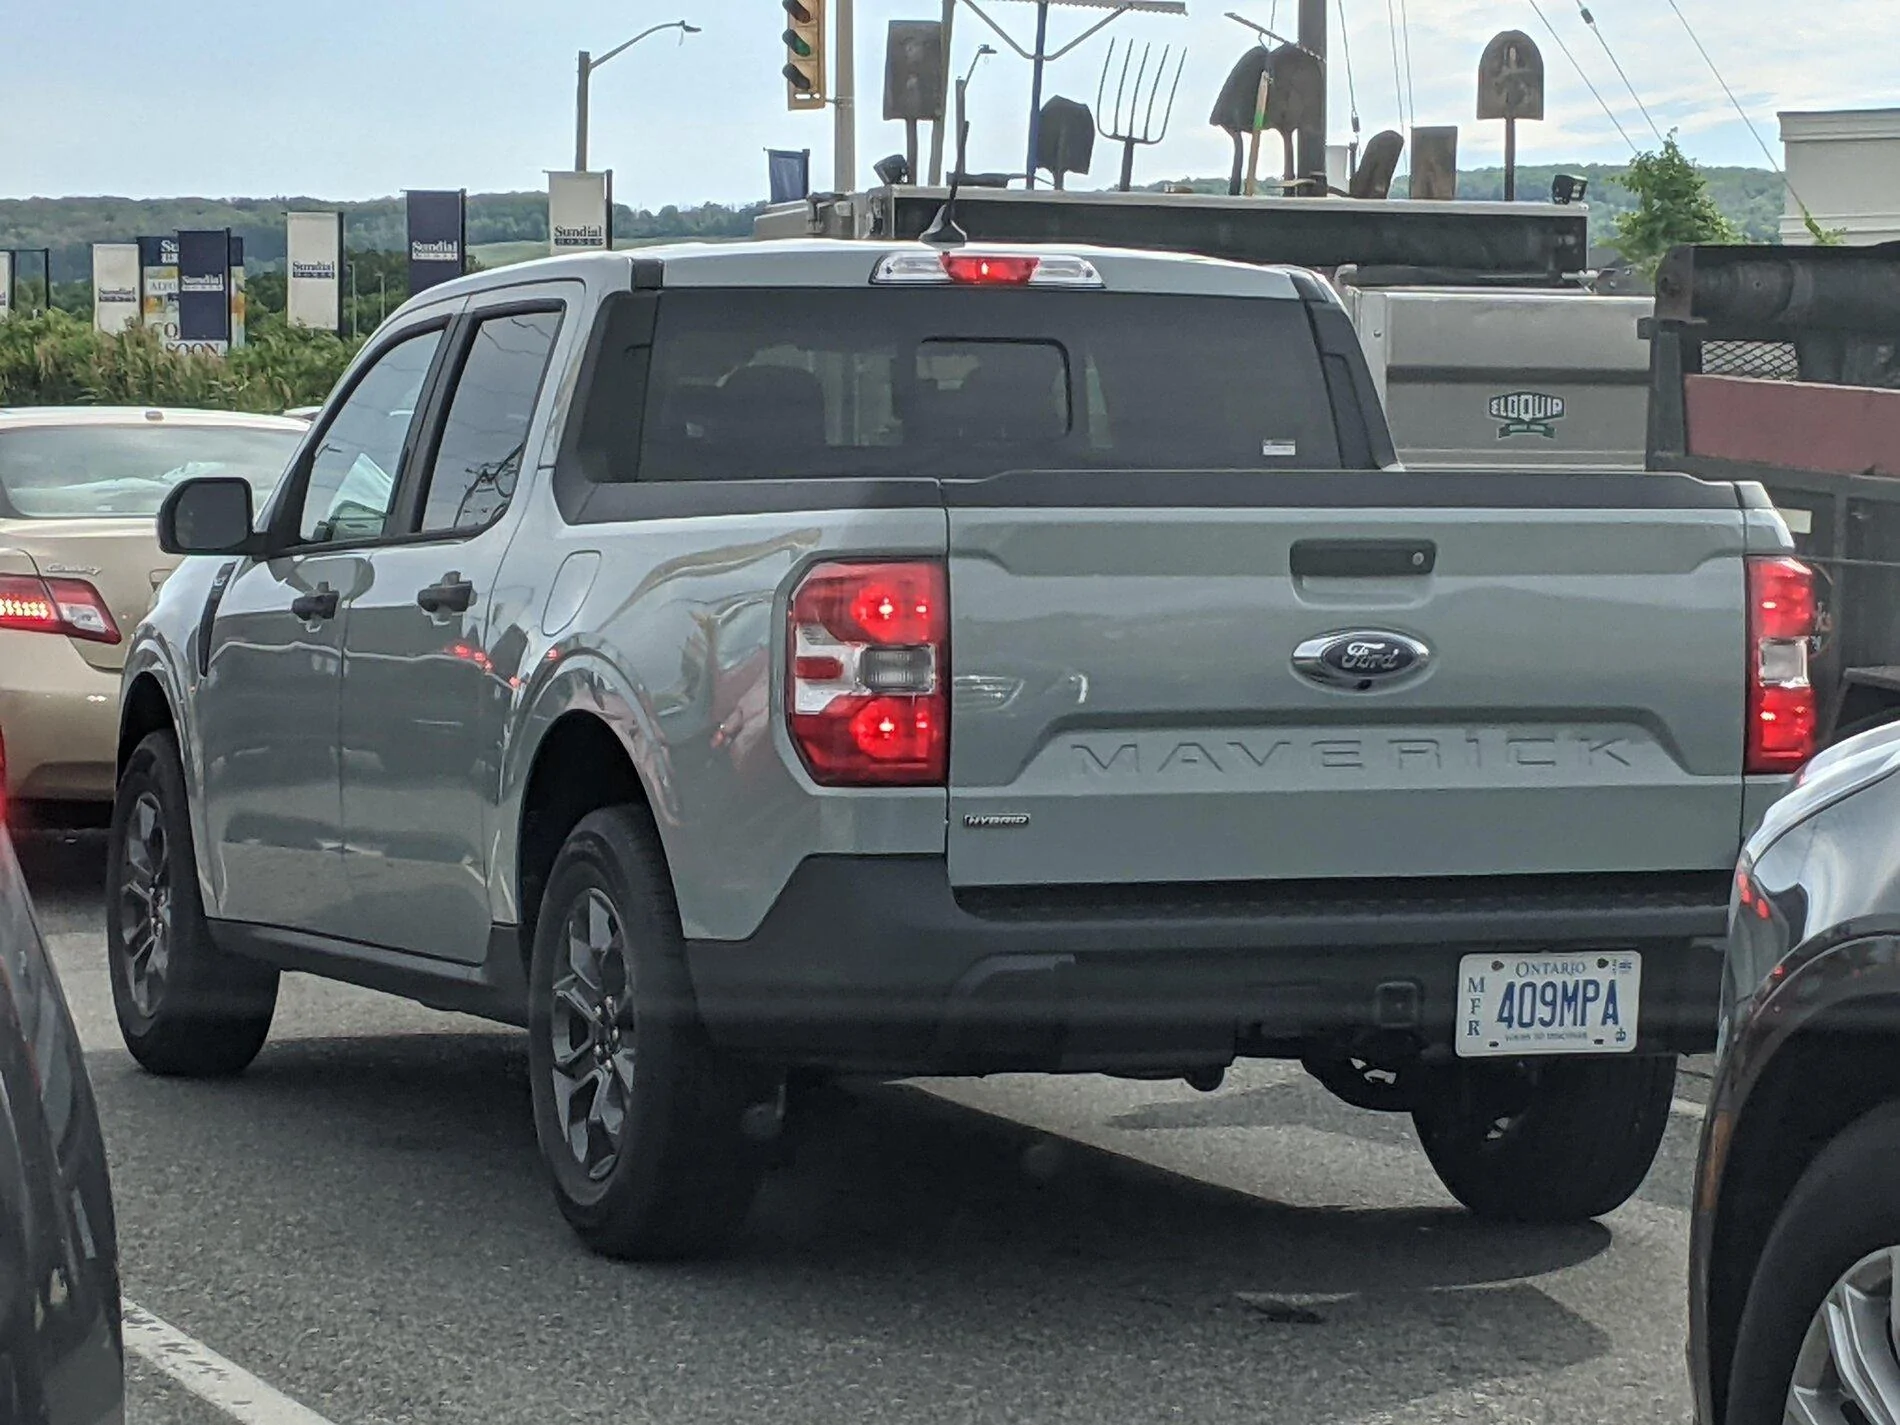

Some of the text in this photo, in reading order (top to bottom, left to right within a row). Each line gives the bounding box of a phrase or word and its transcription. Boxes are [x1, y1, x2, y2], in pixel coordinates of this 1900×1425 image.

[554, 225, 602, 237] Sundial
[412, 240, 458, 252] Sundial
[1490, 394, 1563, 421] ELOQUIP
[1341, 641, 1400, 669] Ford
[1071, 737, 1632, 774] MAVERICK
[967, 815, 1028, 825] HYBRID
[1515, 961, 1587, 977] ONTARIO
[1495, 979, 1619, 1029] 409MPA
